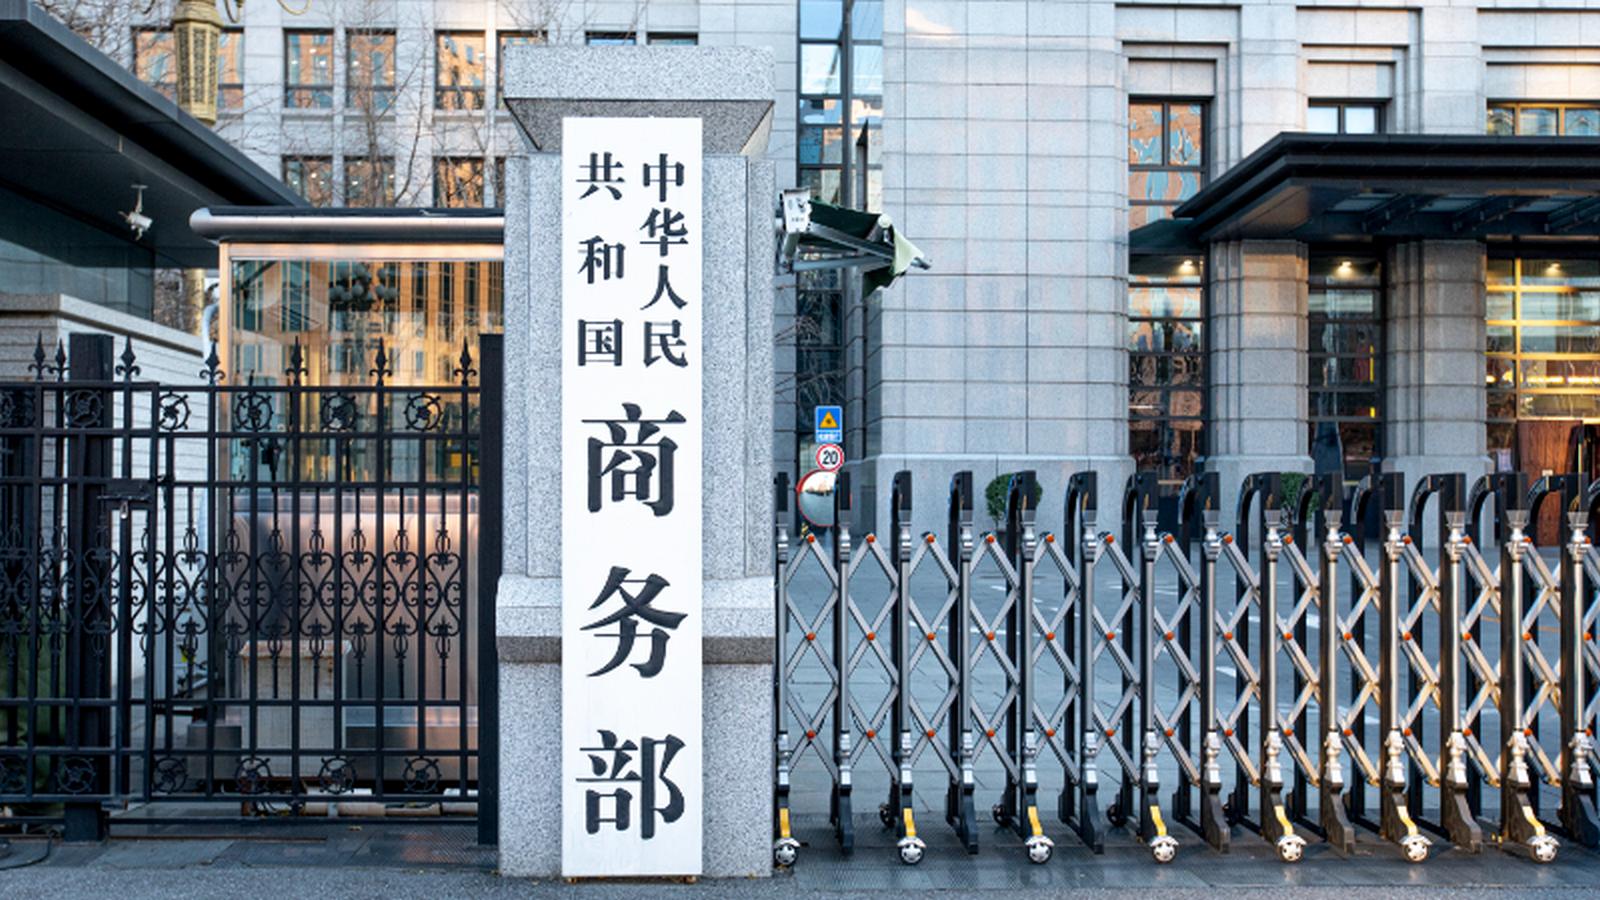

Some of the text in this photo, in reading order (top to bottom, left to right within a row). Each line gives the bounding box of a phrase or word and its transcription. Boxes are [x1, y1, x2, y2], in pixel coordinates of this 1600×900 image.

[576, 152, 626, 367] 共和国
[639, 153, 689, 368] 中华人民
[822, 450, 838, 465] 20
[576, 403, 688, 840] 商务部
